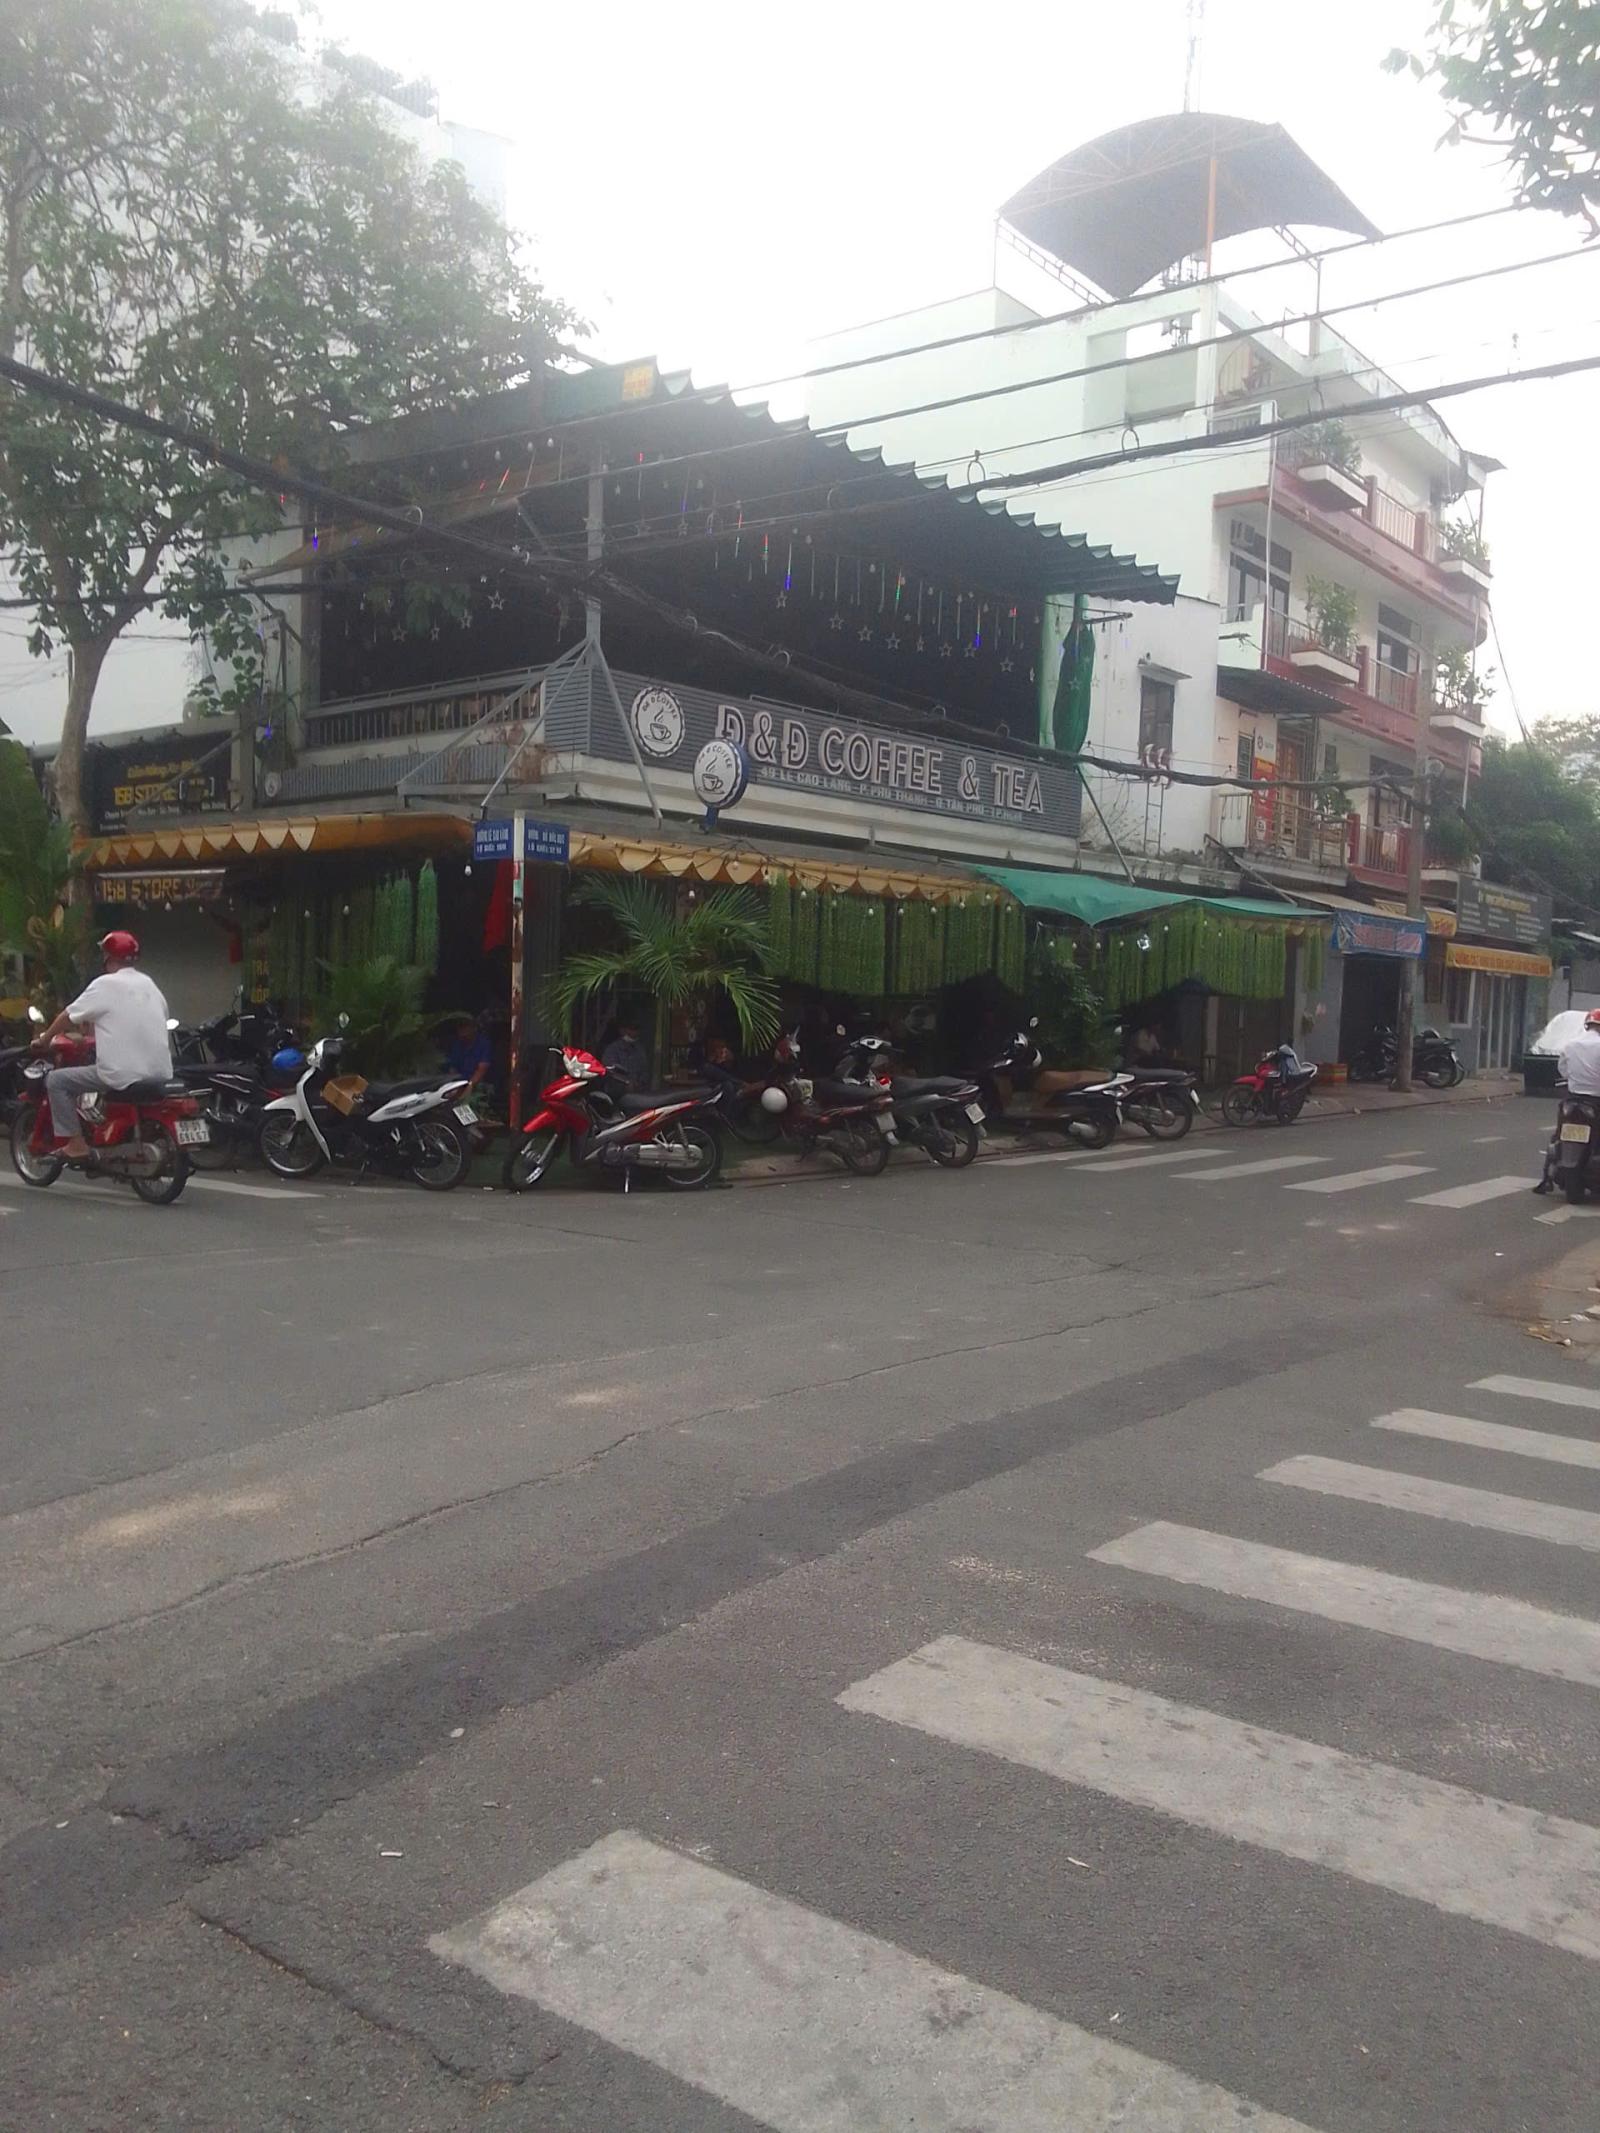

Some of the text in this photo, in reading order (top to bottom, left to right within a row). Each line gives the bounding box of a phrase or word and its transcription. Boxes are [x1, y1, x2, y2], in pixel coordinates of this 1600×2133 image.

[818, 726, 943, 796] COFFEE
[957, 755, 980, 801] &
[991, 763, 1044, 814] TEA
[102, 879, 127, 902] 158
[131, 878, 183, 901] STORE
